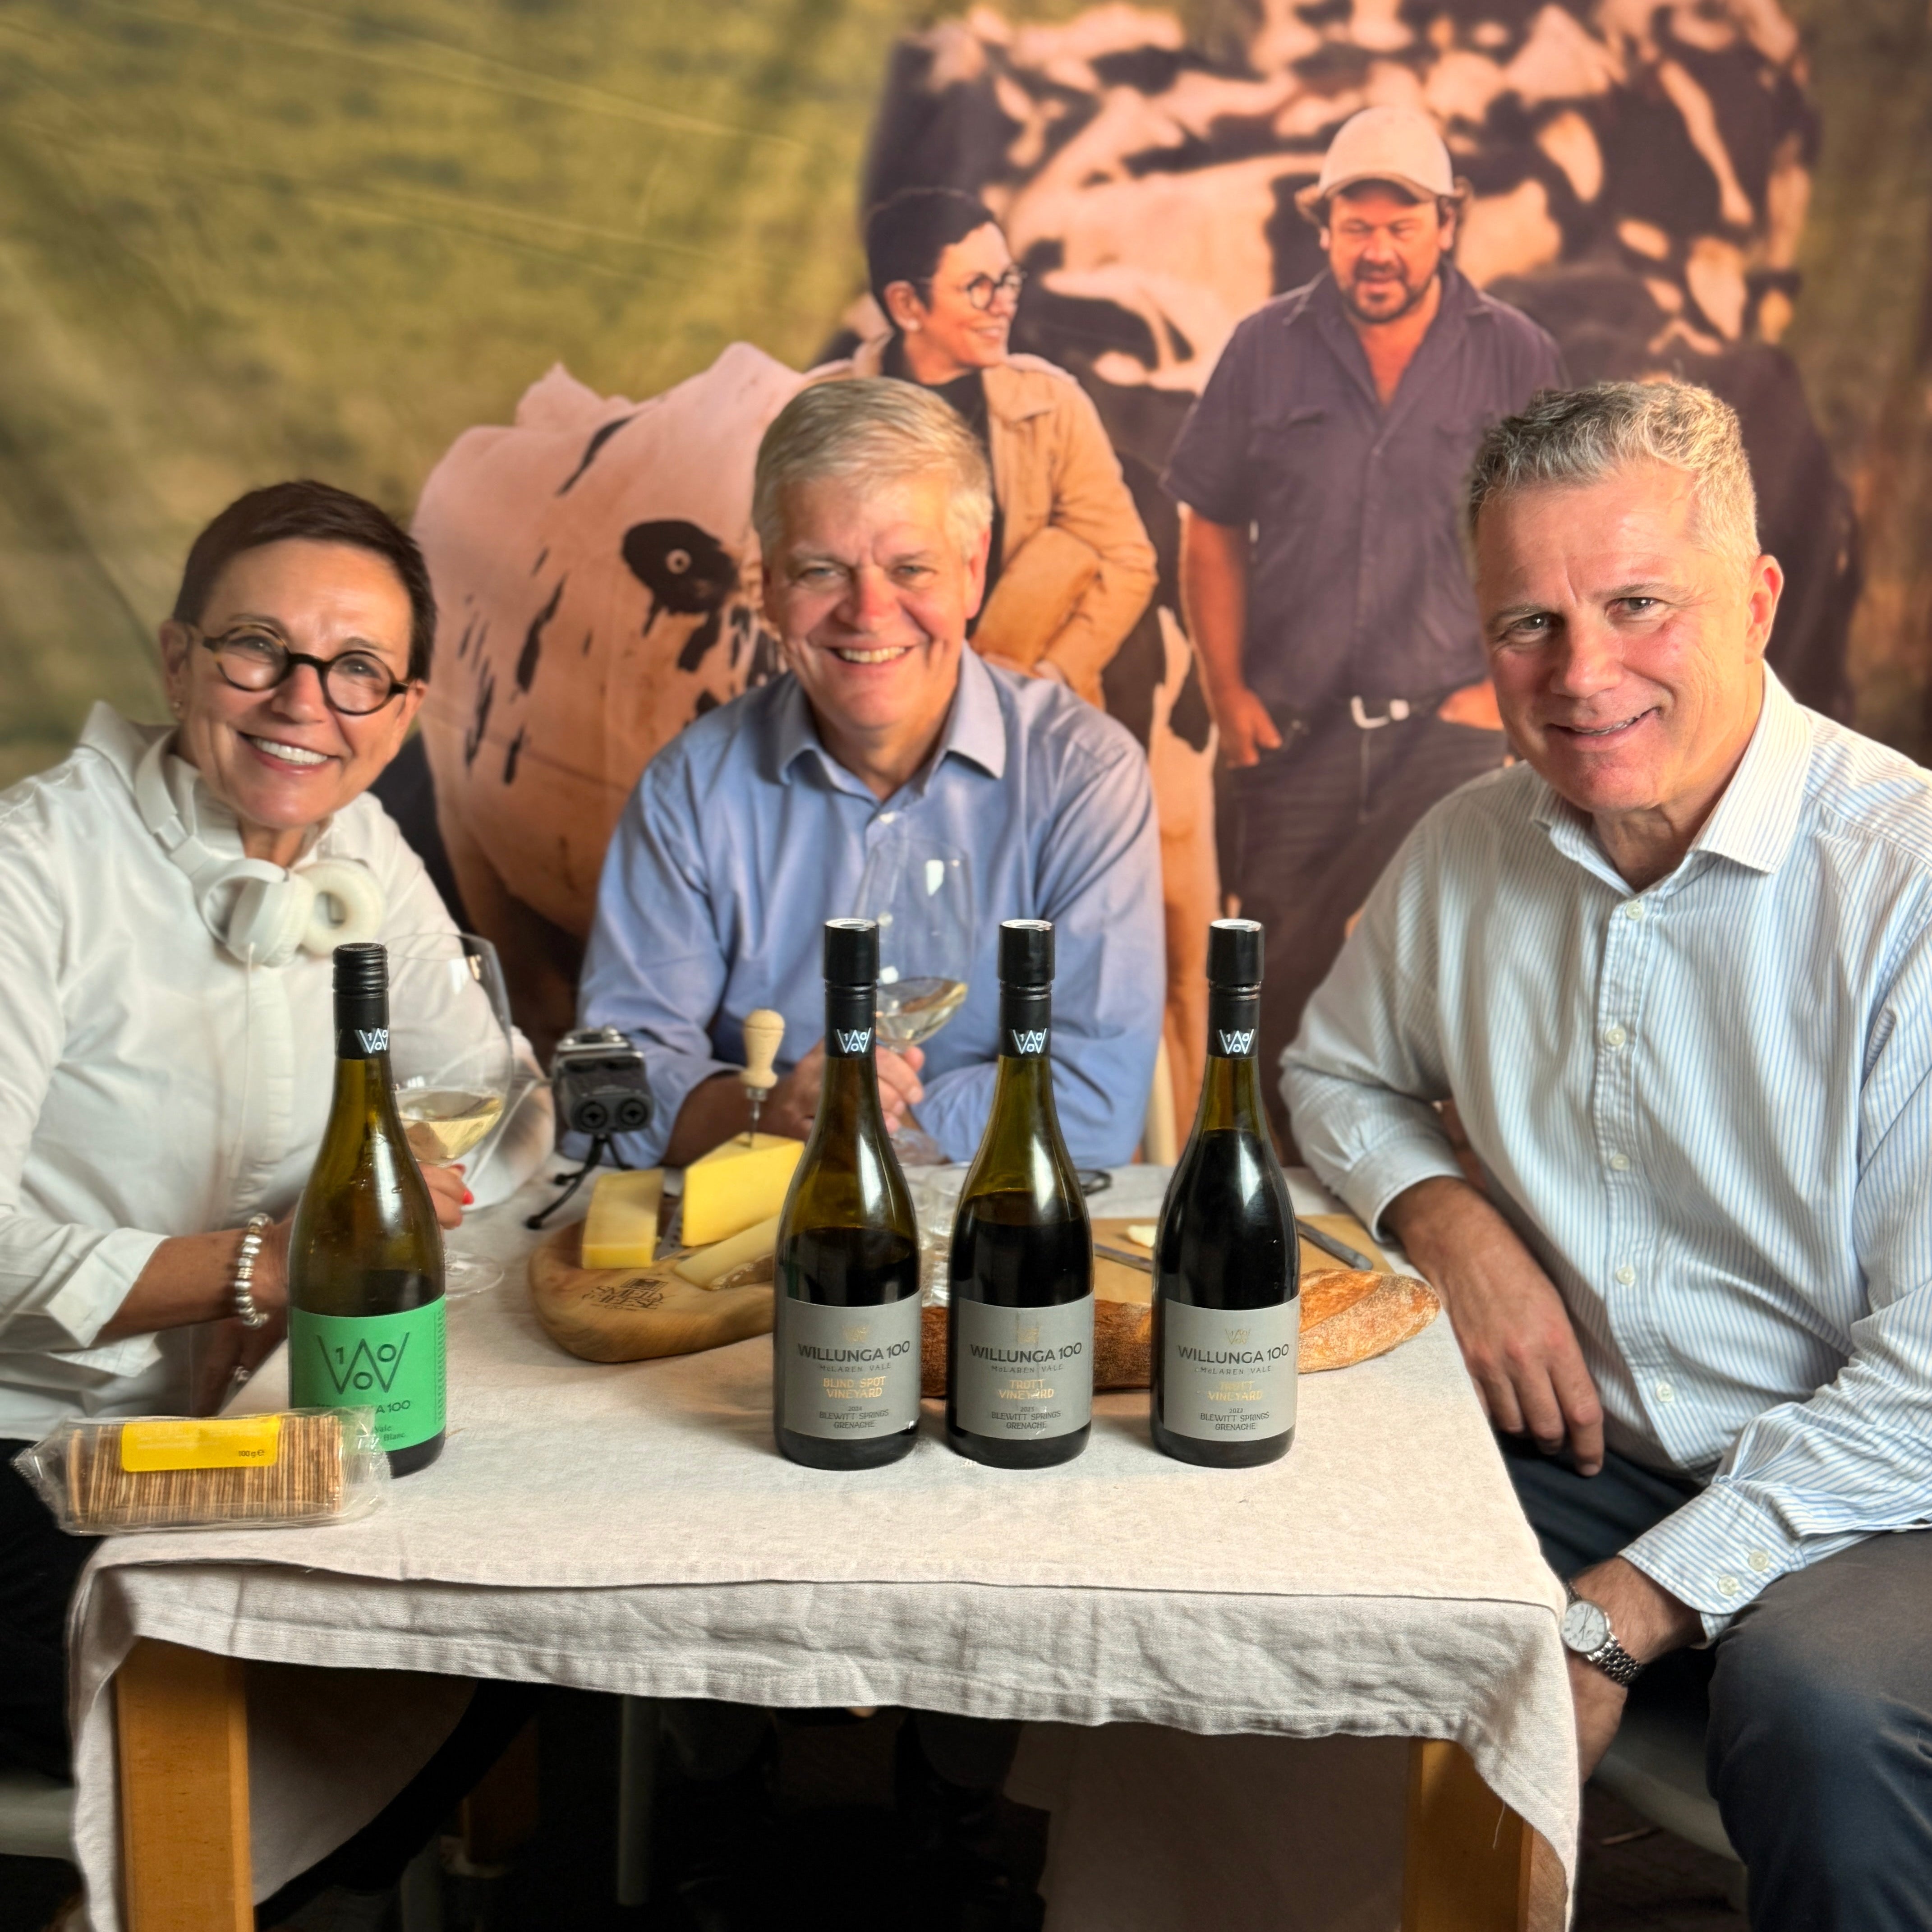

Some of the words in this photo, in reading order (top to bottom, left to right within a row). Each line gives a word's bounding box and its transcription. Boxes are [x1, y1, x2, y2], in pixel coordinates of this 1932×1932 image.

[798, 1343, 883, 1362] WILLUNGA
[887, 1341, 910, 1358] 100
[970, 1344, 1056, 1362] WILLUNGA
[1059, 1342, 1082, 1359] 100
[1178, 1345, 1264, 1364] WILLUNGA
[1267, 1343, 1289, 1361] 100
[869, 1362, 891, 1371] VALE
[1042, 1364, 1063, 1372] VALE
[1251, 1366, 1271, 1374] VALE
[823, 1378, 854, 1388] BLIND
[860, 1376, 886, 1388] SPOT
[1009, 1379, 1045, 1389] TROTT
[826, 1388, 883, 1398] VINEYARD
[387, 1400, 410, 1412] 100
[819, 1411, 855, 1420] BLEWITT
[859, 1409, 889, 1419] SPRINGS
[992, 1411, 1027, 1421] BLEWITT
[1031, 1410, 1061, 1420] SPRINGS
[1201, 1413, 1236, 1422] BLEWITT
[1240, 1411, 1270, 1422] SPRINGS
[383, 1433, 405, 1441] Blanc
